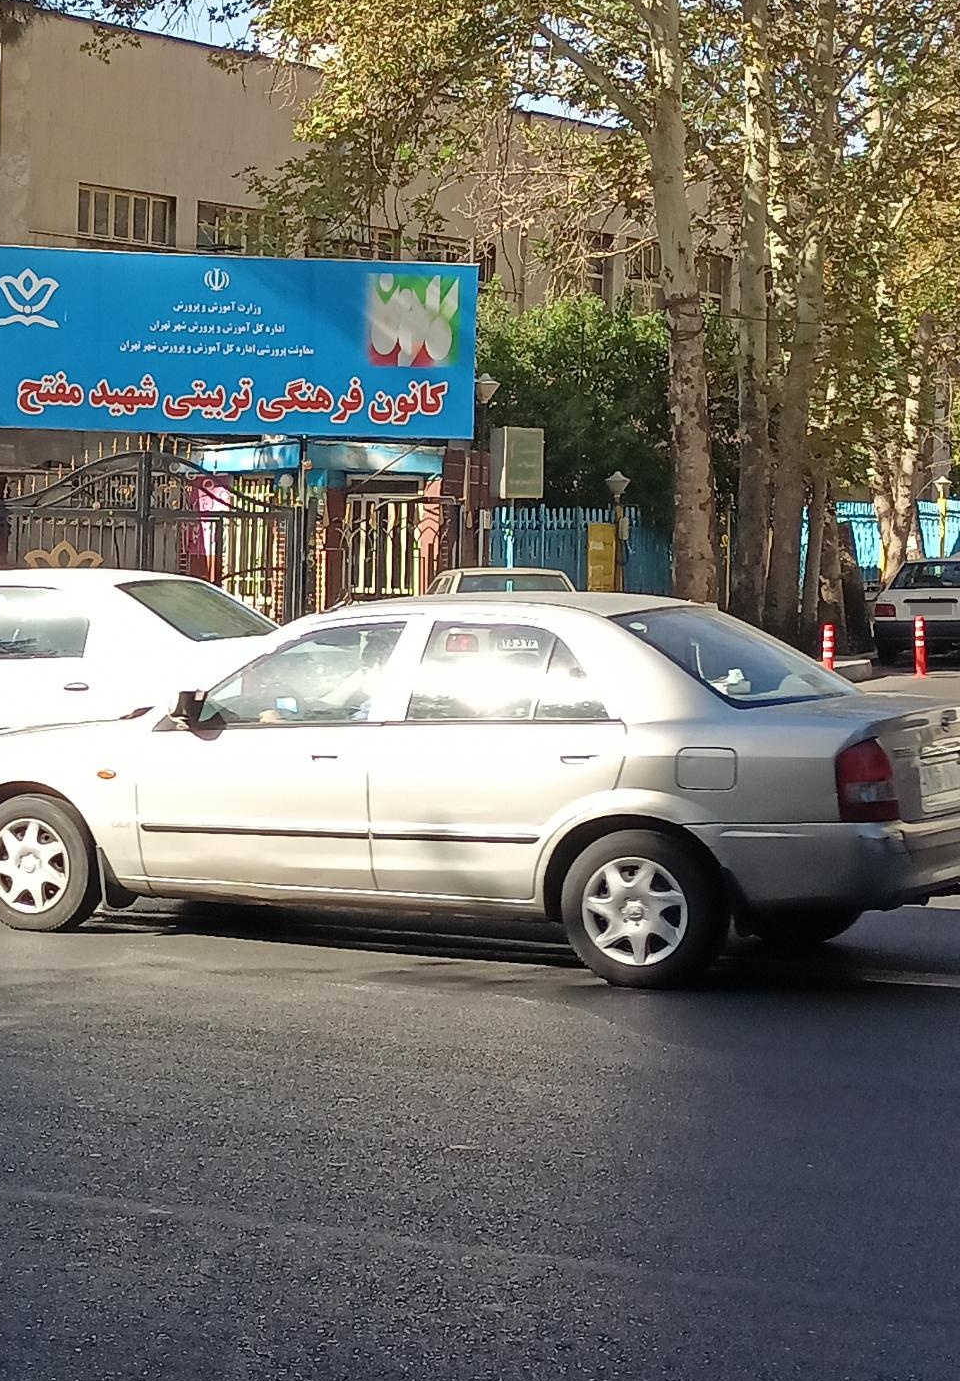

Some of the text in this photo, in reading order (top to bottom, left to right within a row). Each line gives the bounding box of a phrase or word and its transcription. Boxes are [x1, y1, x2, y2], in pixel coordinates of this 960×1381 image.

[173, 300, 262, 315] وزارت آموزش و پرورش
[150, 320, 285, 336] اداره کل آموزش و پرورش شهر تهران
[120, 340, 314, 357] معاونت پرورشی اداره کل آموزش و پرورش شهر تهران
[17, 371, 447, 425] کانون فرهنگی تربیتی شهید مفتح
